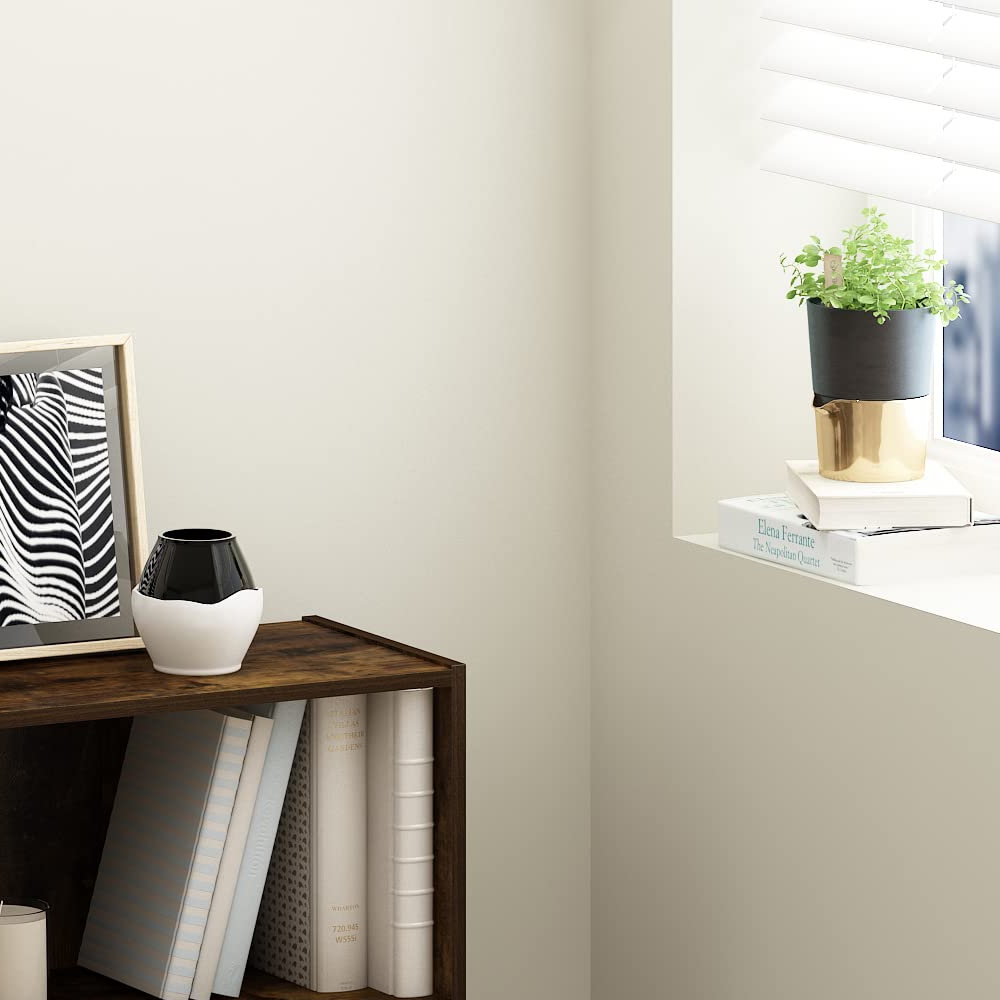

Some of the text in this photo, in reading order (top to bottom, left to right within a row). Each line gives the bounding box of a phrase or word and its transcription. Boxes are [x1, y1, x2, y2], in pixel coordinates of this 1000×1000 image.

[758, 518, 815, 548] Elena Ferrante
[753, 538, 764, 552] The
[765, 541, 797, 560] Neapolitan
